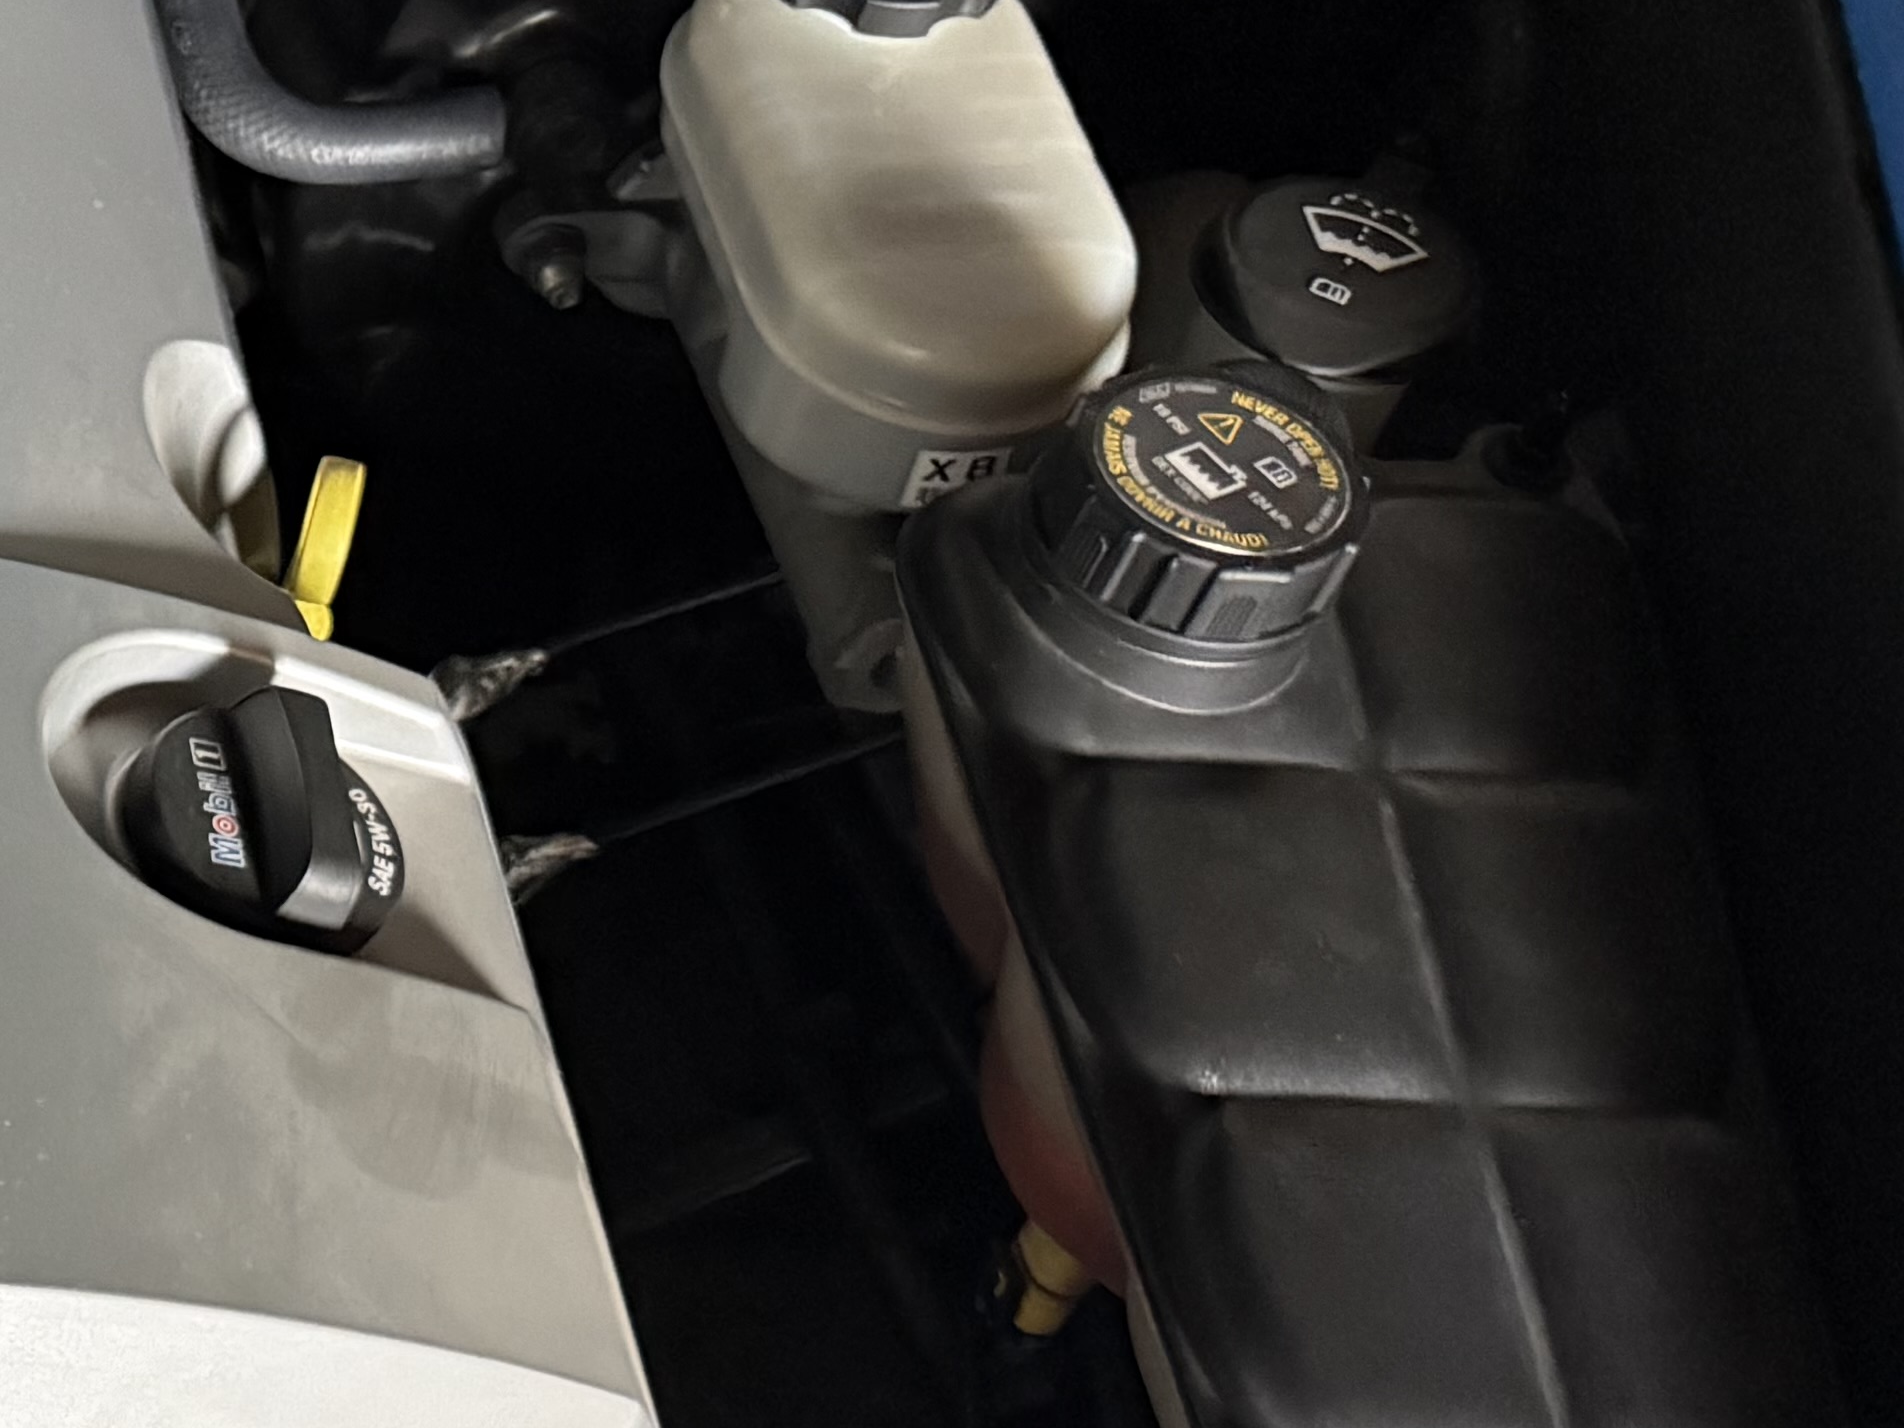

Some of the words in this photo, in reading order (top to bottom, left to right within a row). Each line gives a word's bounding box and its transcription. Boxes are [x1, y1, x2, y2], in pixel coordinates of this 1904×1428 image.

[1231, 390, 1290, 427] NEVER
[1285, 422, 1326, 459] OPEN
[197, 772, 245, 868] Mobil
[367, 857, 397, 897] SAE
